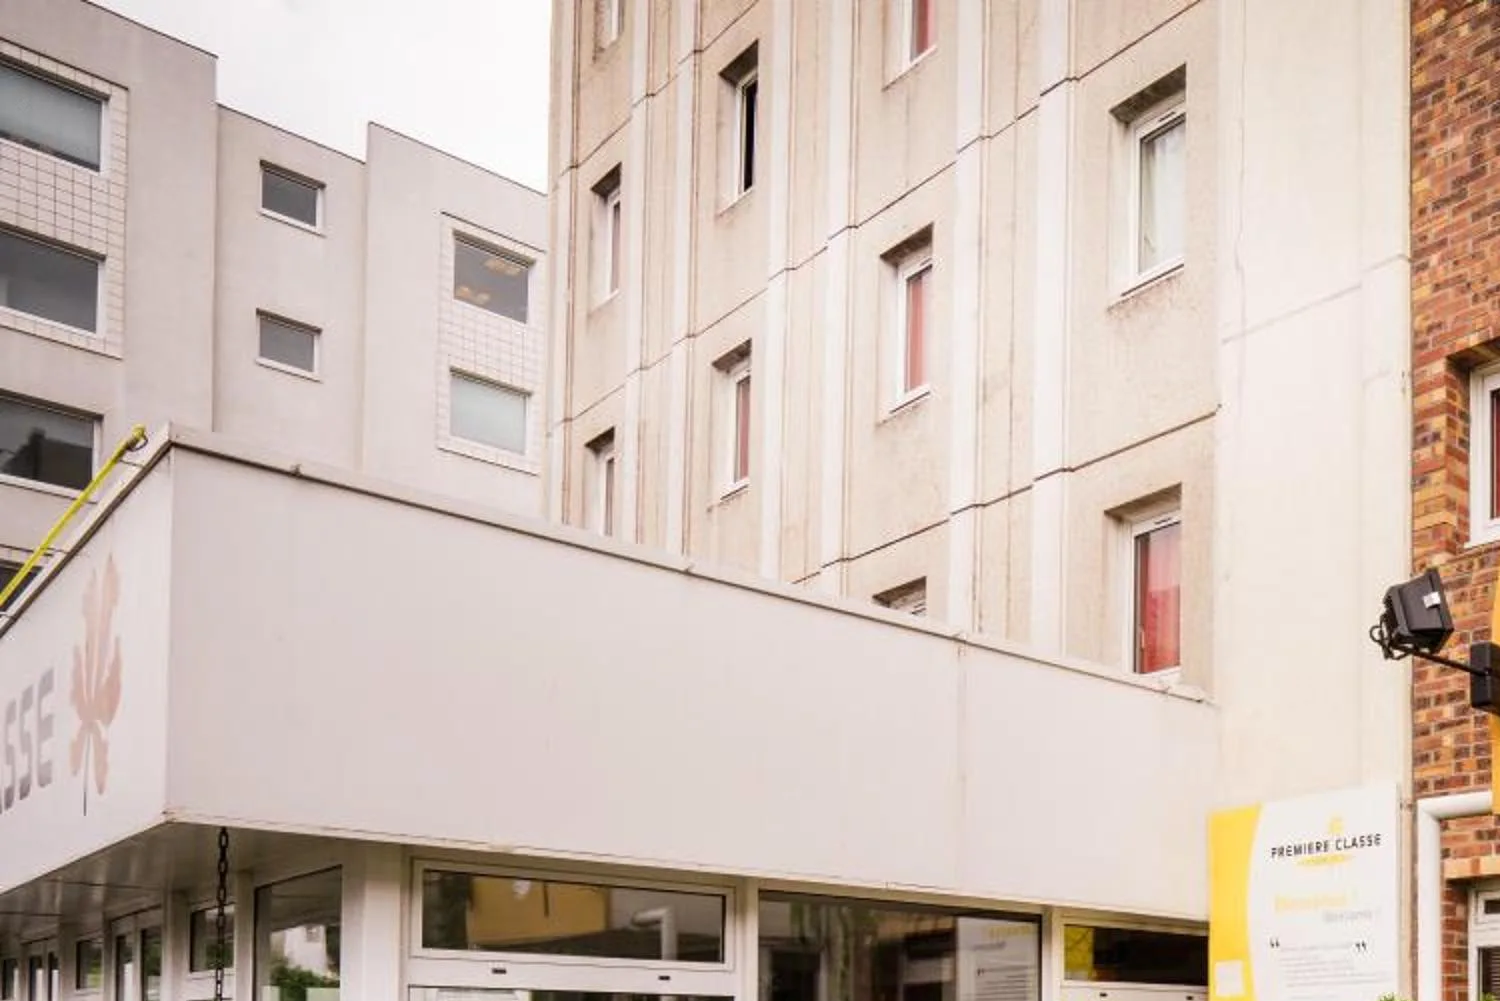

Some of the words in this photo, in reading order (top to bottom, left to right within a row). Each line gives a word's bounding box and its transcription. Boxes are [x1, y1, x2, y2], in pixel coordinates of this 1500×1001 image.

[0, 669, 54, 813] SSE
[1271, 841, 1328, 858] PREMIERE
[1336, 834, 1381, 850] CLASSE
